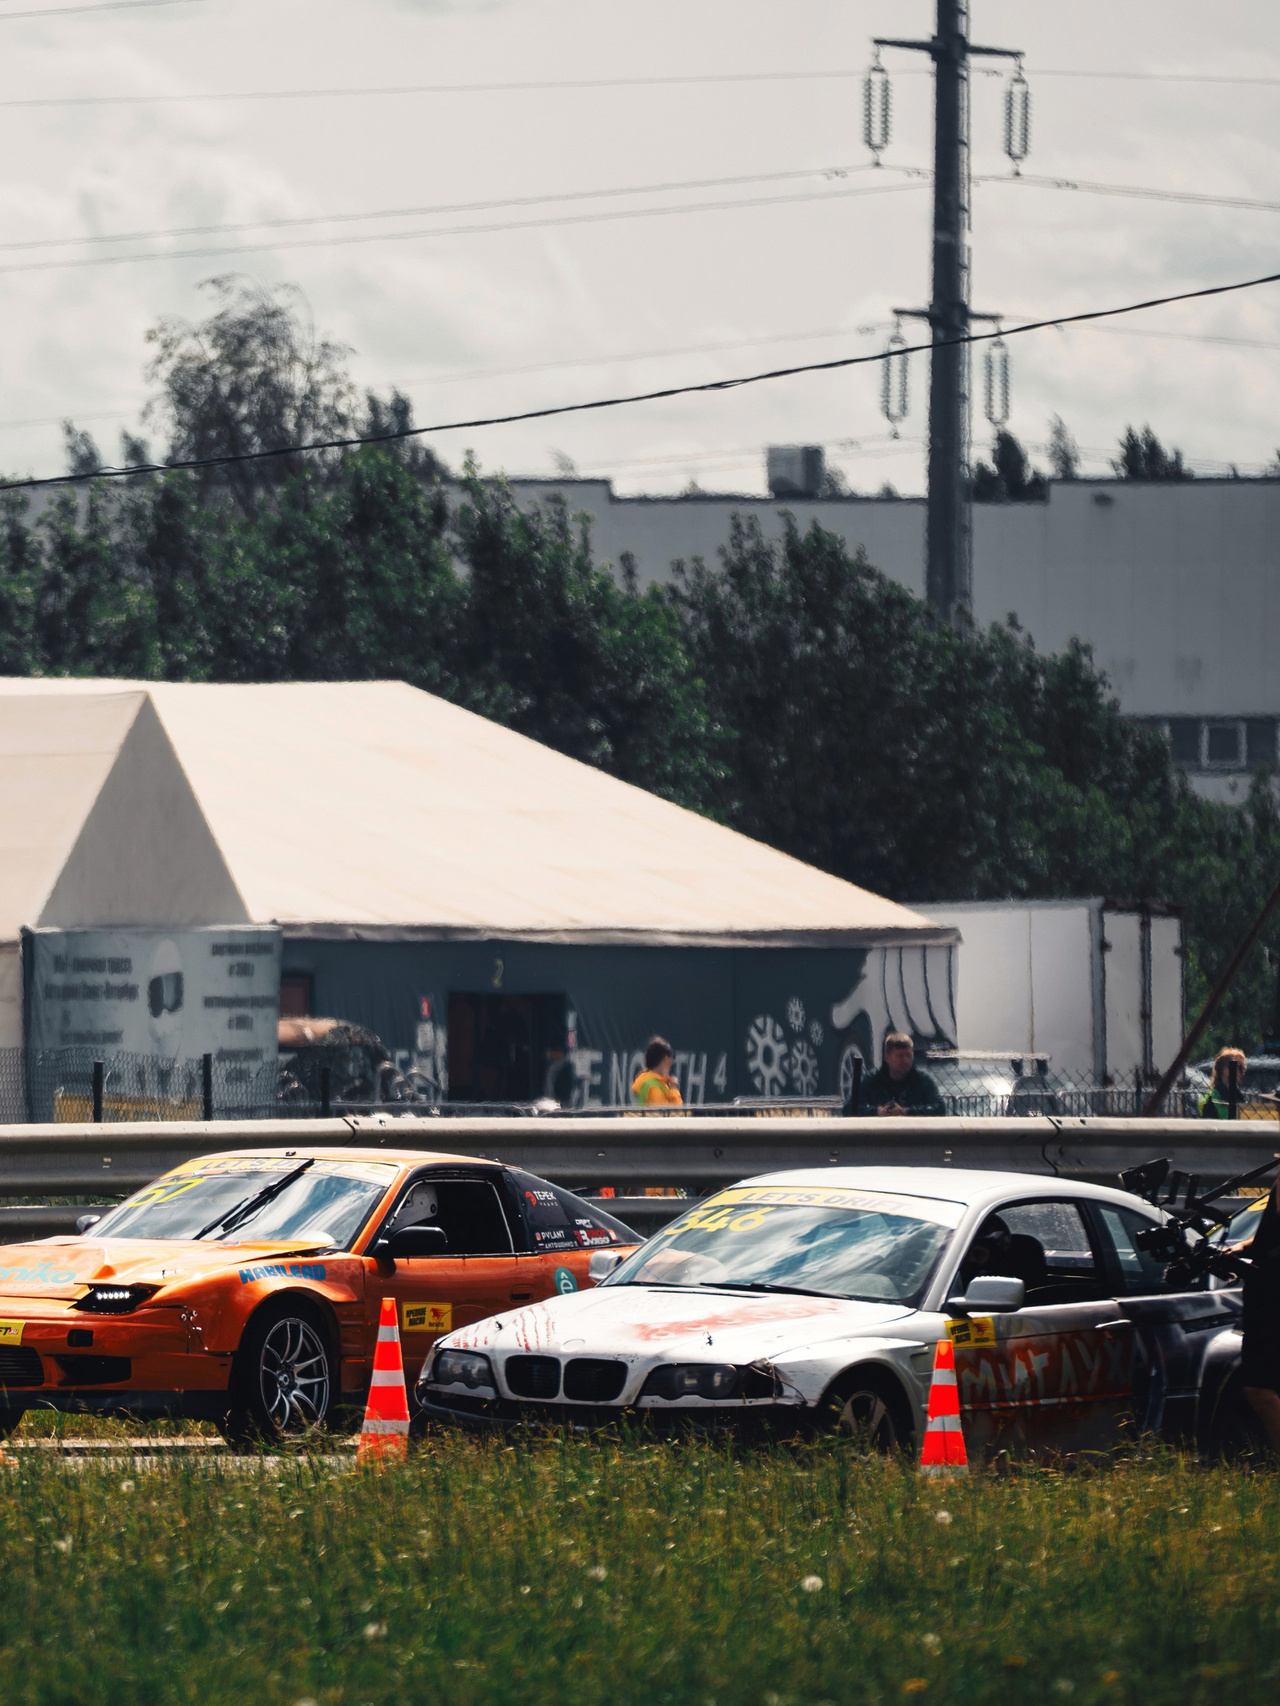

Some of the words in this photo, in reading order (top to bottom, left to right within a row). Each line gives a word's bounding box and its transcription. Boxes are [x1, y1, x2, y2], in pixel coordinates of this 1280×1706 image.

[610, 1051, 707, 1105] NOTH
[739, 1191, 814, 1203] LET'S
[664, 1207, 776, 1236] 346
[239, 1264, 326, 1284] HABILEAD
